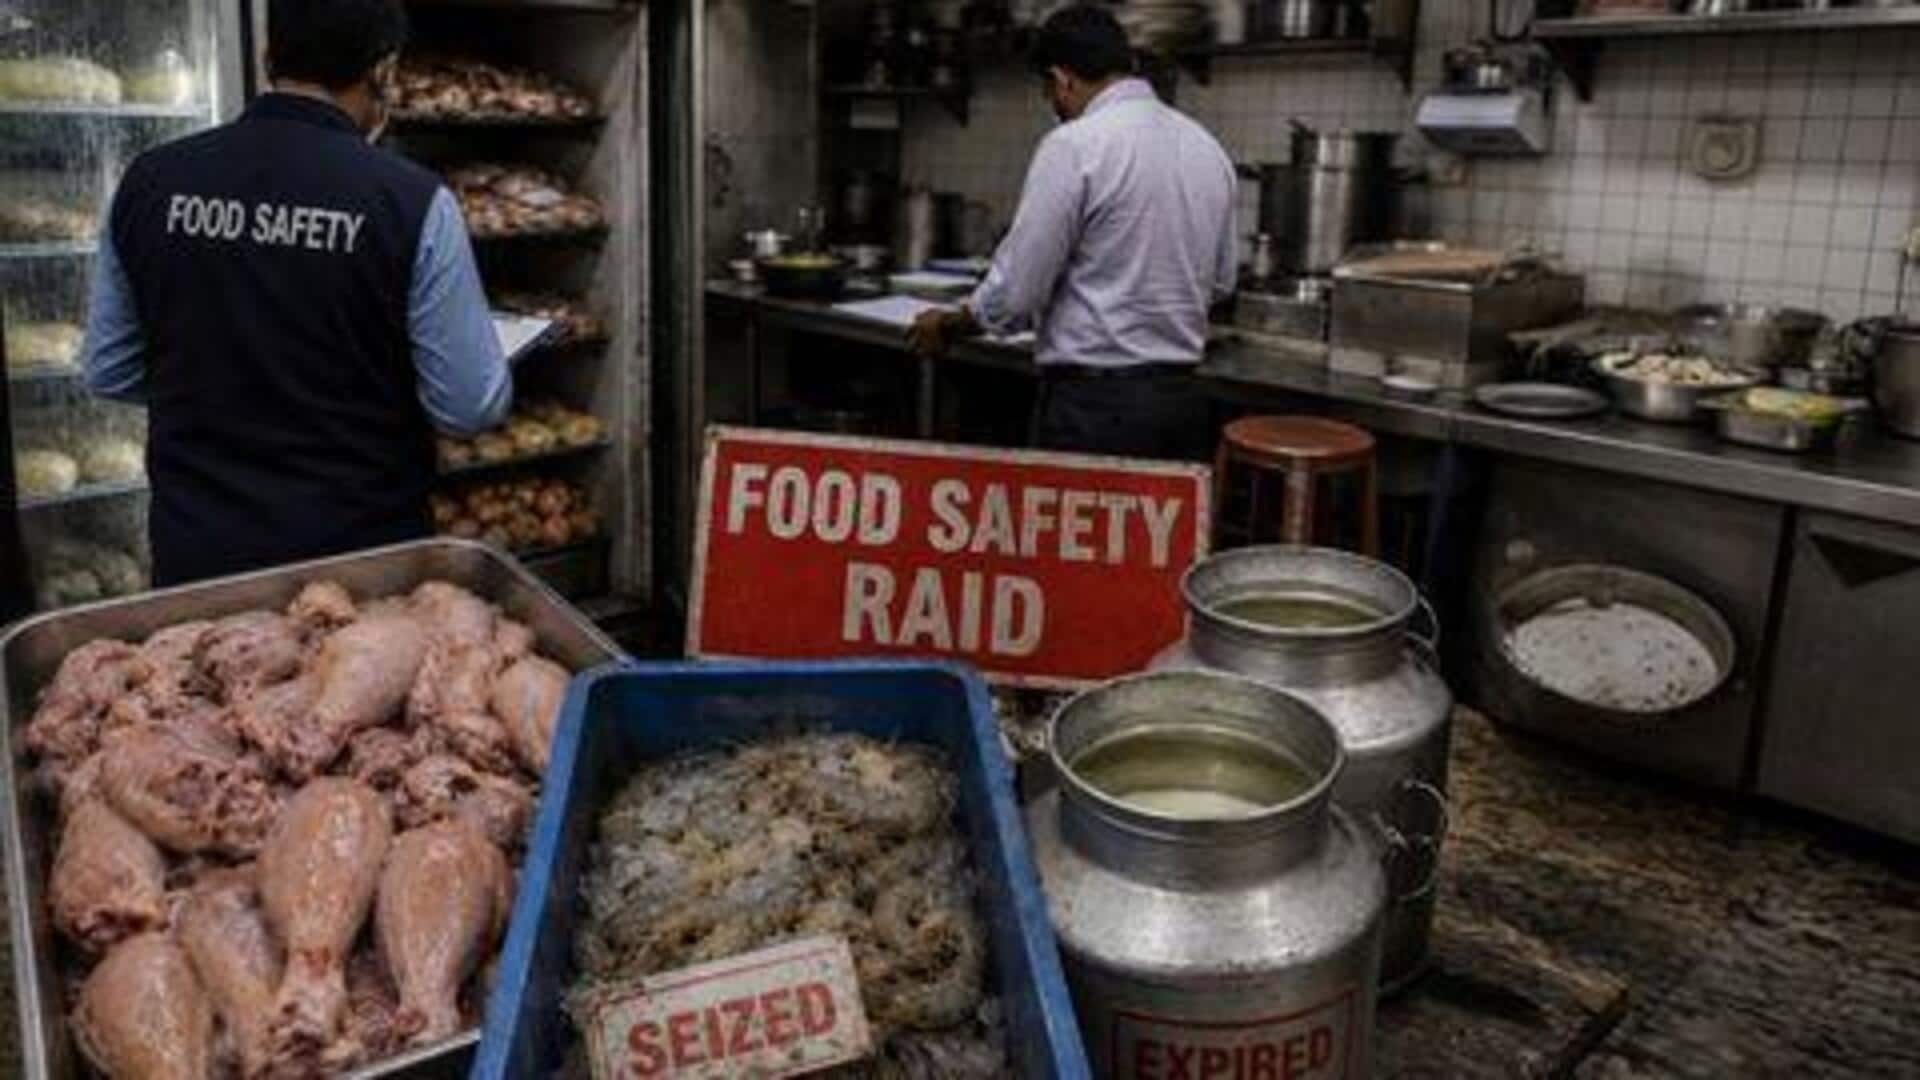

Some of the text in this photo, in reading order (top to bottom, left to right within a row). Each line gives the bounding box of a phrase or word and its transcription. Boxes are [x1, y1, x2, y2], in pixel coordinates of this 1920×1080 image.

[167, 195, 365, 252] FOOD SAFETY
[727, 463, 1182, 568] FOOD SAFETY
[842, 561, 1045, 656] RAID
[628, 983, 837, 1076] SEIZED
[1136, 1026, 1333, 1080] EXPIRED
